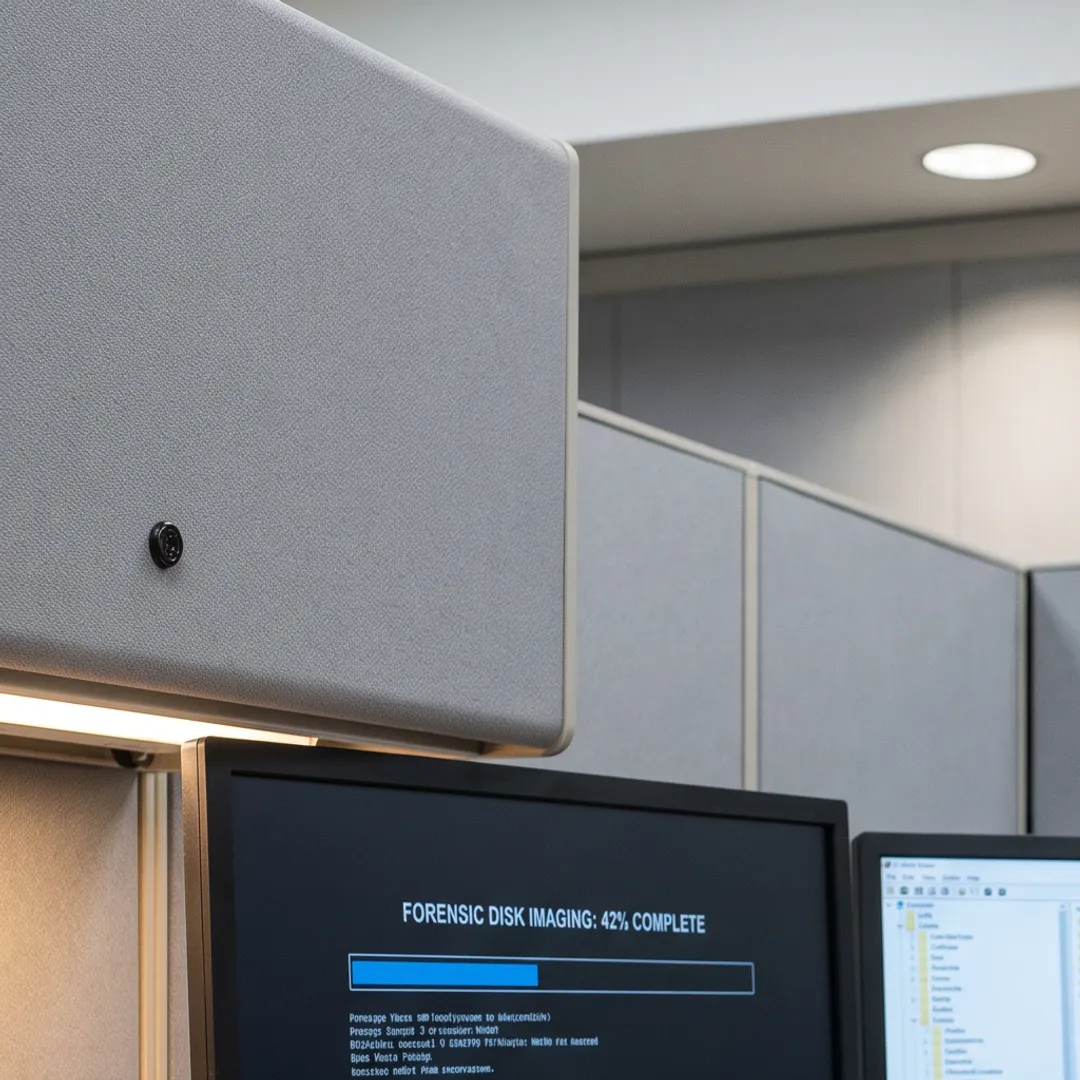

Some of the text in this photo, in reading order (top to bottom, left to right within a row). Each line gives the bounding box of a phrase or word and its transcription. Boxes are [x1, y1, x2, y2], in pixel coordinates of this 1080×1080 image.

[402, 901, 706, 933] FORENSIC DISK IMAGING: 42% COMPLETE
